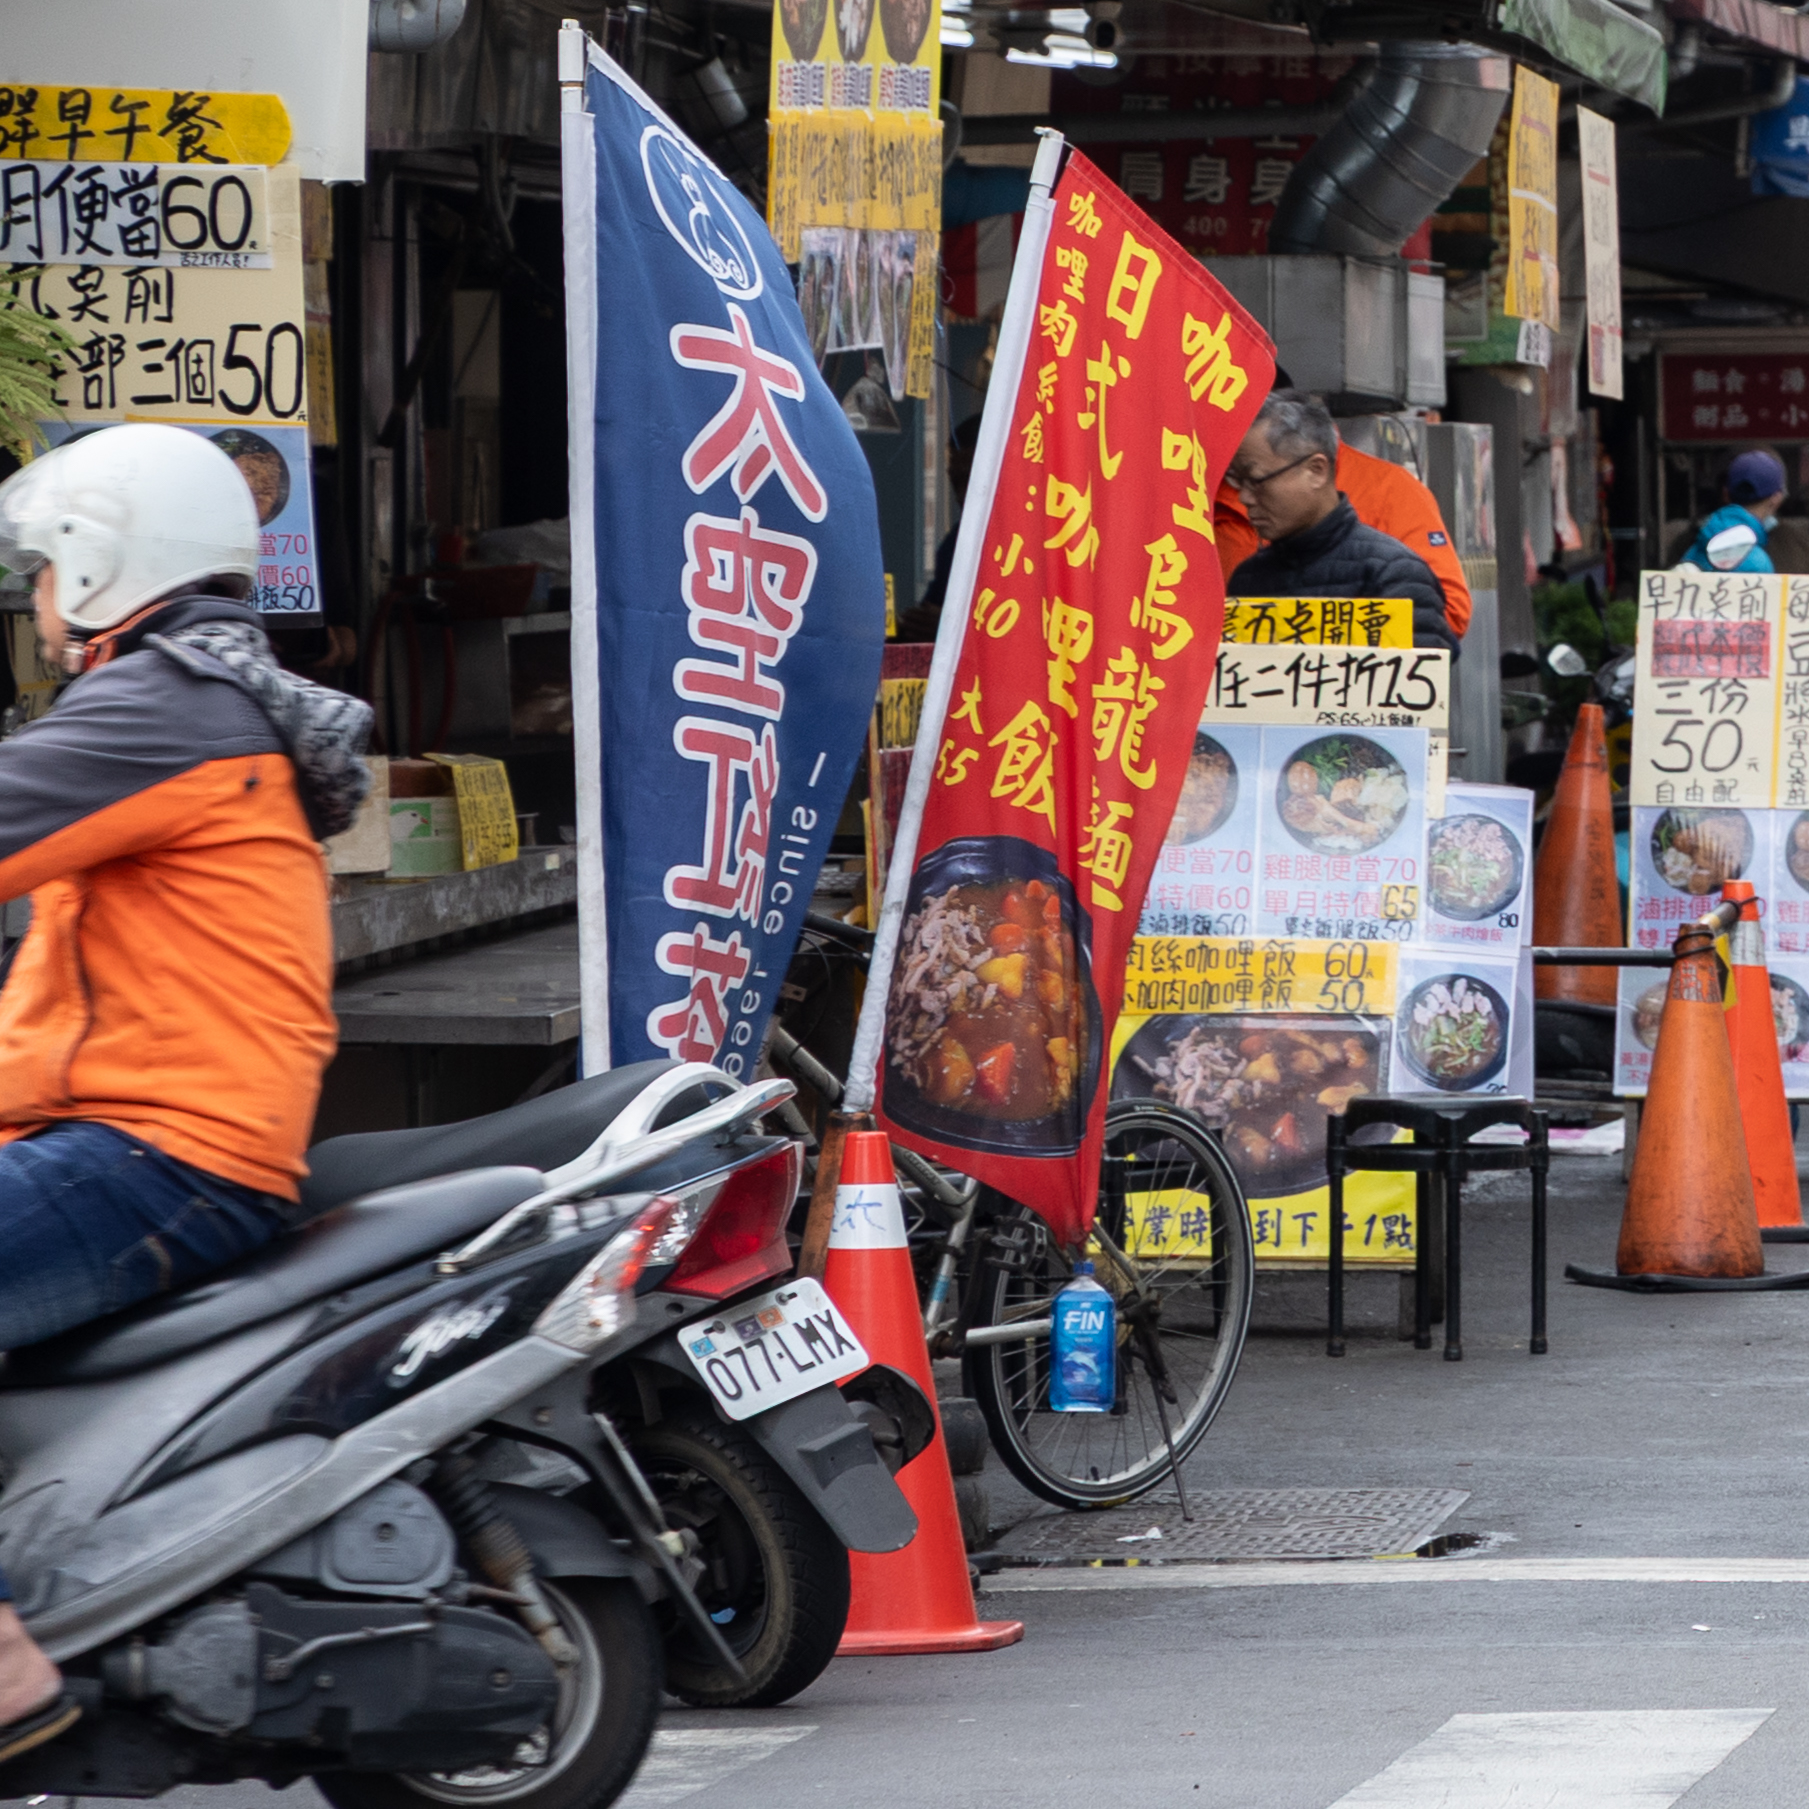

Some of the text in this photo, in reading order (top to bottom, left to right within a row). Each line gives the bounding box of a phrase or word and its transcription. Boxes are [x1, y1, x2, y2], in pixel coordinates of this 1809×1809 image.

[1655, 678, 1750, 715] 三份
[1655, 778, 1740, 804] 自由配
[1262, 854, 1418, 882] 雞腿便當70
[1063, 1309, 1106, 1332] FIN
